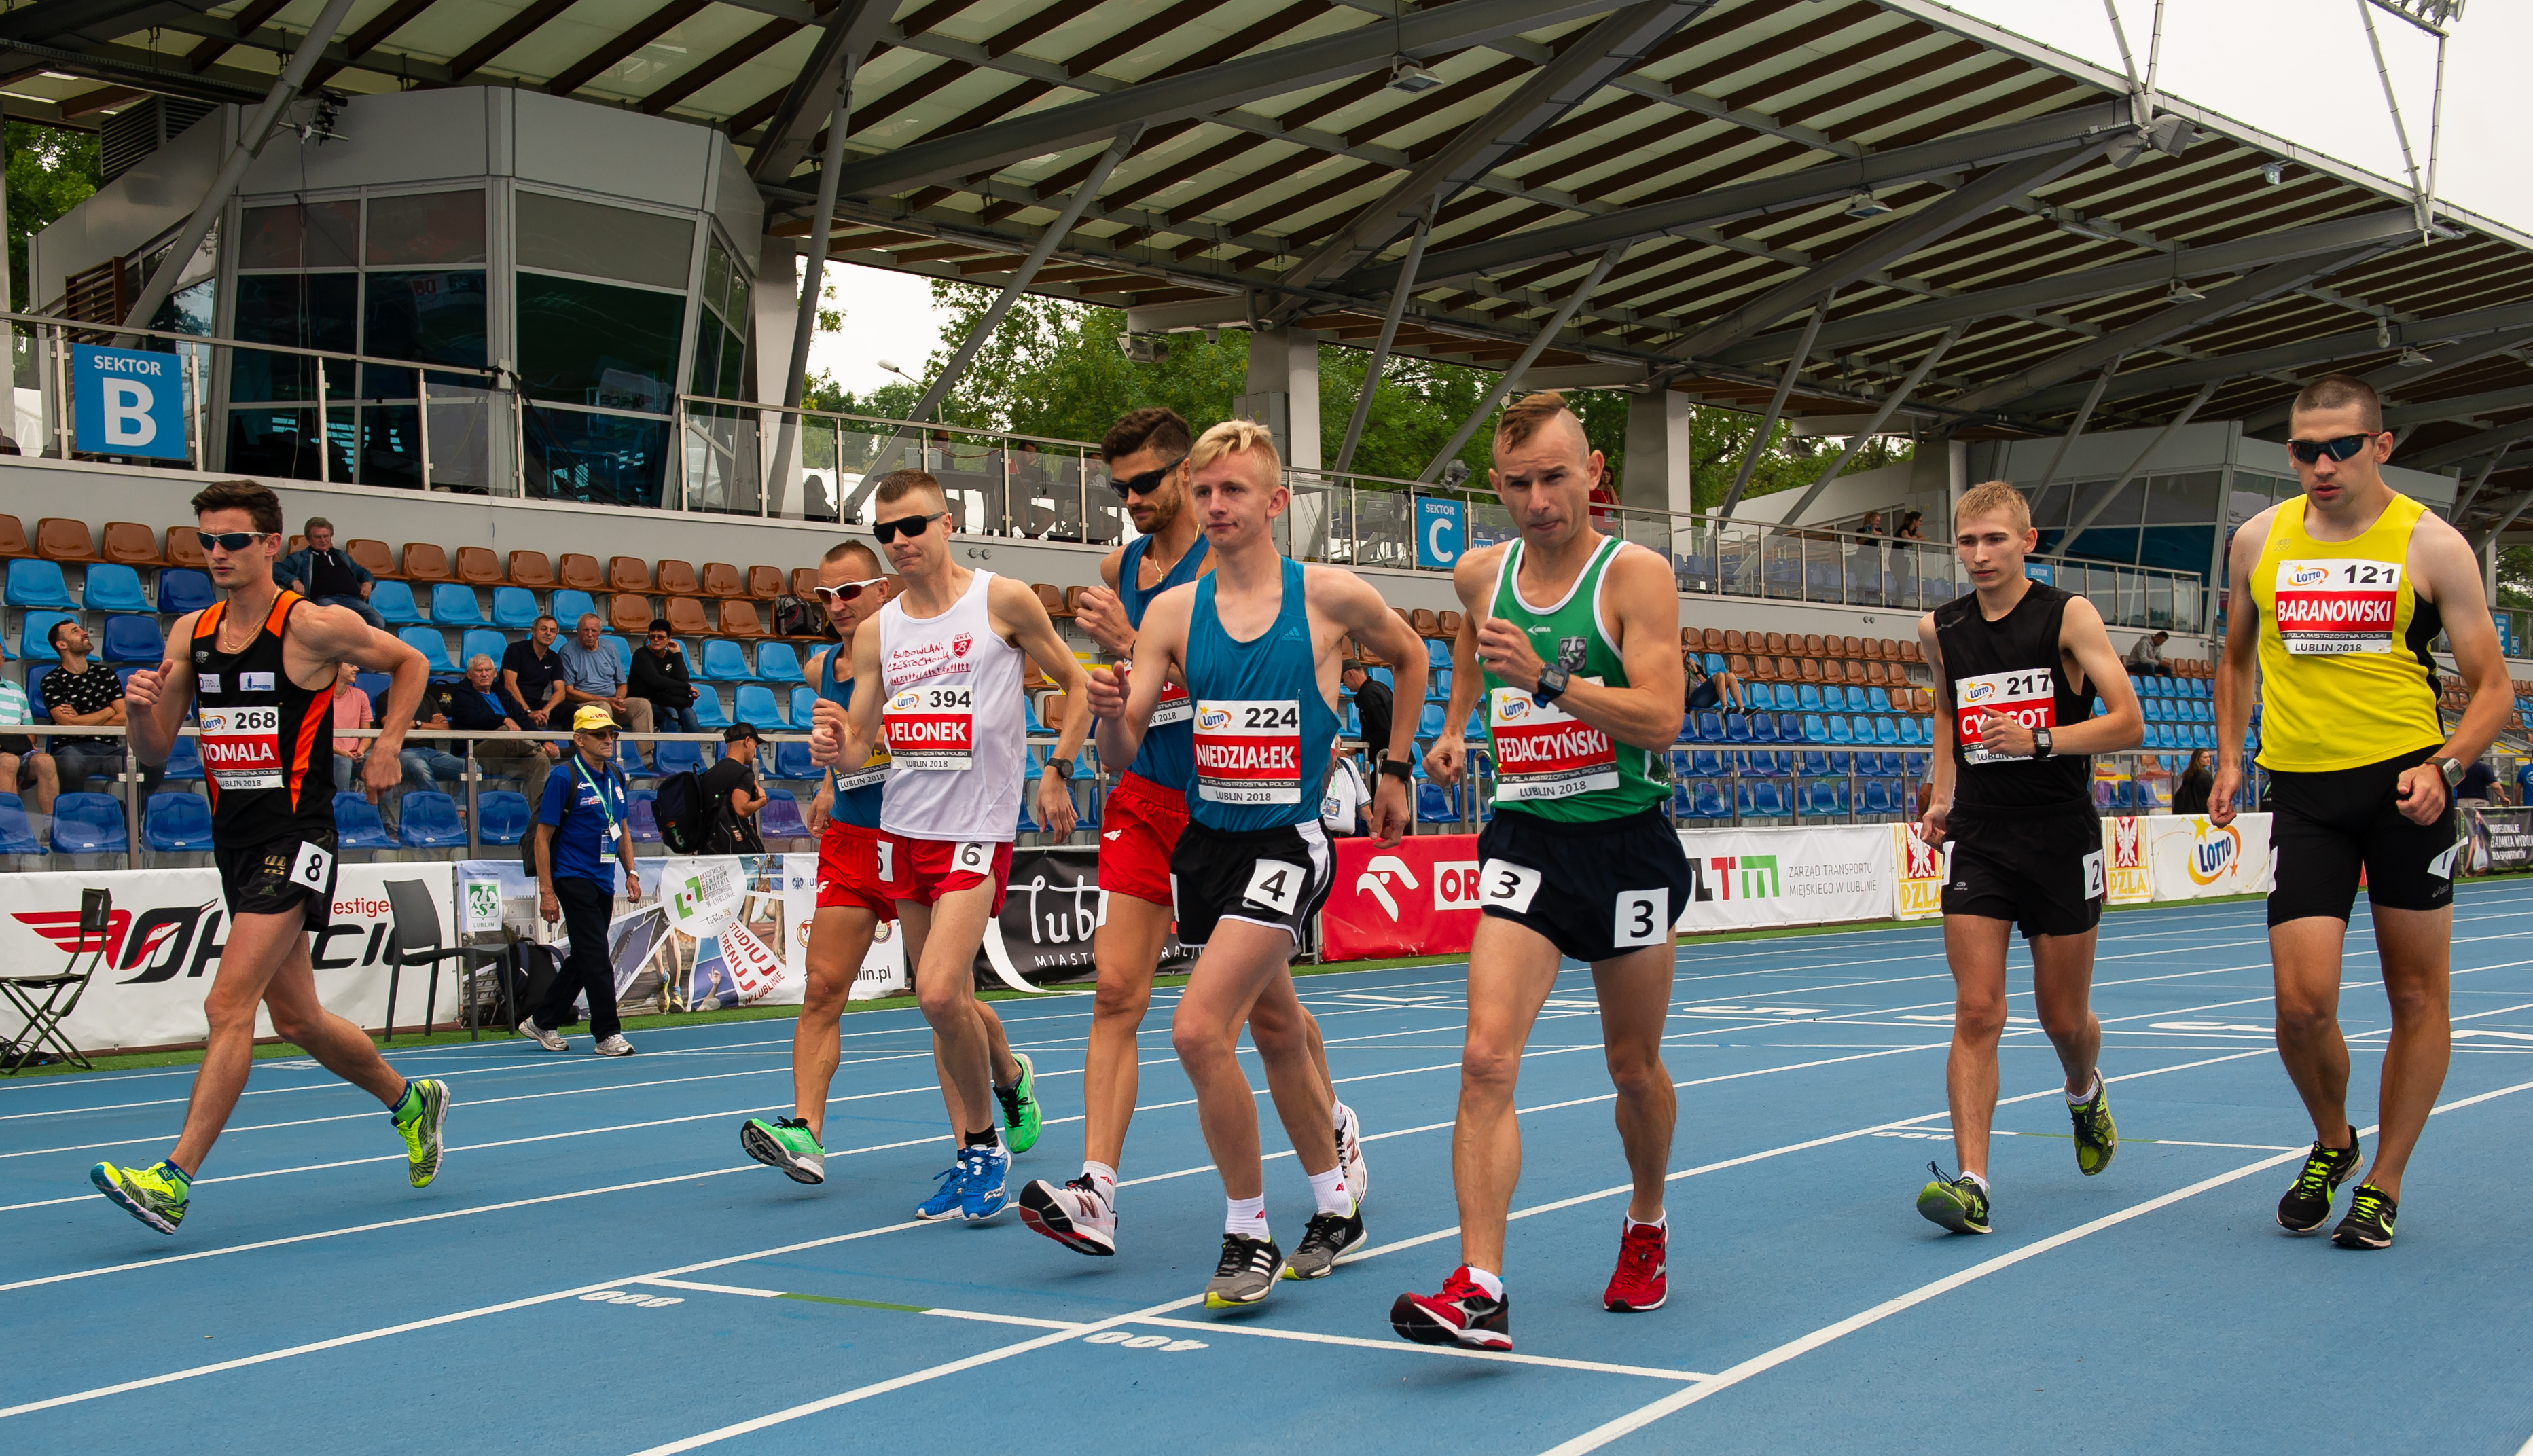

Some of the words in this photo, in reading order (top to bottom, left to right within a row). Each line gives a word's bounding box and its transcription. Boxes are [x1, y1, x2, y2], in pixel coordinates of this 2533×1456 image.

[94, 355, 161, 376] SEKTOR
[103, 377, 156, 446] B
[1425, 503, 1455, 515] SEKTOR
[1429, 517, 1454, 562] C
[2296, 571, 2321, 583] LOTTO
[2344, 564, 2394, 584] 121
[2278, 600, 2392, 622] BARANOWSKI
[2295, 642, 2333, 652] LUBLIN
[2336, 643, 2363, 652] 2018
[1970, 686, 1989, 699] LOTTO
[2007, 674, 2049, 696] 217
[897, 696, 914, 707] LOTTO
[930, 691, 971, 708] 394
[1172, 699, 1191, 707] POLSK
[1503, 701, 1525, 716] LOTTO
[201, 717, 221, 729] LOTTO
[235, 712, 276, 729] 268
[1158, 712, 1177, 723] 2018
[1202, 714, 1225, 726] LOTTO
[1244, 708, 1298, 729] 224
[1962, 707, 2049, 735] CYGOT
[890, 722, 967, 742] JELONEK
[202, 742, 275, 762] TOMALA
[1496, 727, 1609, 763] FEDACZYŃSKI
[1196, 744, 1295, 769] NIEDZIAŁEK
[1581, 765, 1611, 774] POLSKI
[840, 778, 865, 789] LUBLIN
[867, 774, 885, 782] 2018
[1520, 786, 1555, 797] LUBLIN
[1558, 780, 1587, 794] 2018
[1215, 790, 1243, 801] LUBLIN
[1246, 793, 1272, 801] 2018
[1102, 829, 1122, 841] 4F
[961, 843, 982, 867] 6
[2198, 835, 2231, 873] LOTTO
[304, 854, 323, 882] 8
[1789, 865, 1820, 880] ZARZĄD
[1823, 862, 1873, 876] TRANSPORTU
[2091, 859, 2100, 891] 2
[701, 871, 727, 888] CENTRUM
[702, 877, 730, 894] SZKOLENIA
[1259, 869, 1288, 903] 4
[1490, 871, 1522, 900] 3
[1789, 882, 1833, 898] MIEJSKIEGO
[1836, 882, 1844, 894] W
[1846, 879, 1877, 893] LUBLINIE
[2109, 871, 2148, 895] PZLA
[712, 890, 735, 905] LUBLINIE
[1902, 881, 1942, 911] PZLA
[1630, 900, 1654, 939] 3
[728, 922, 777, 977] STUDIUJ
[720, 932, 757, 992] TRENUJ
[754, 970, 785, 1002] LUBLINIE
